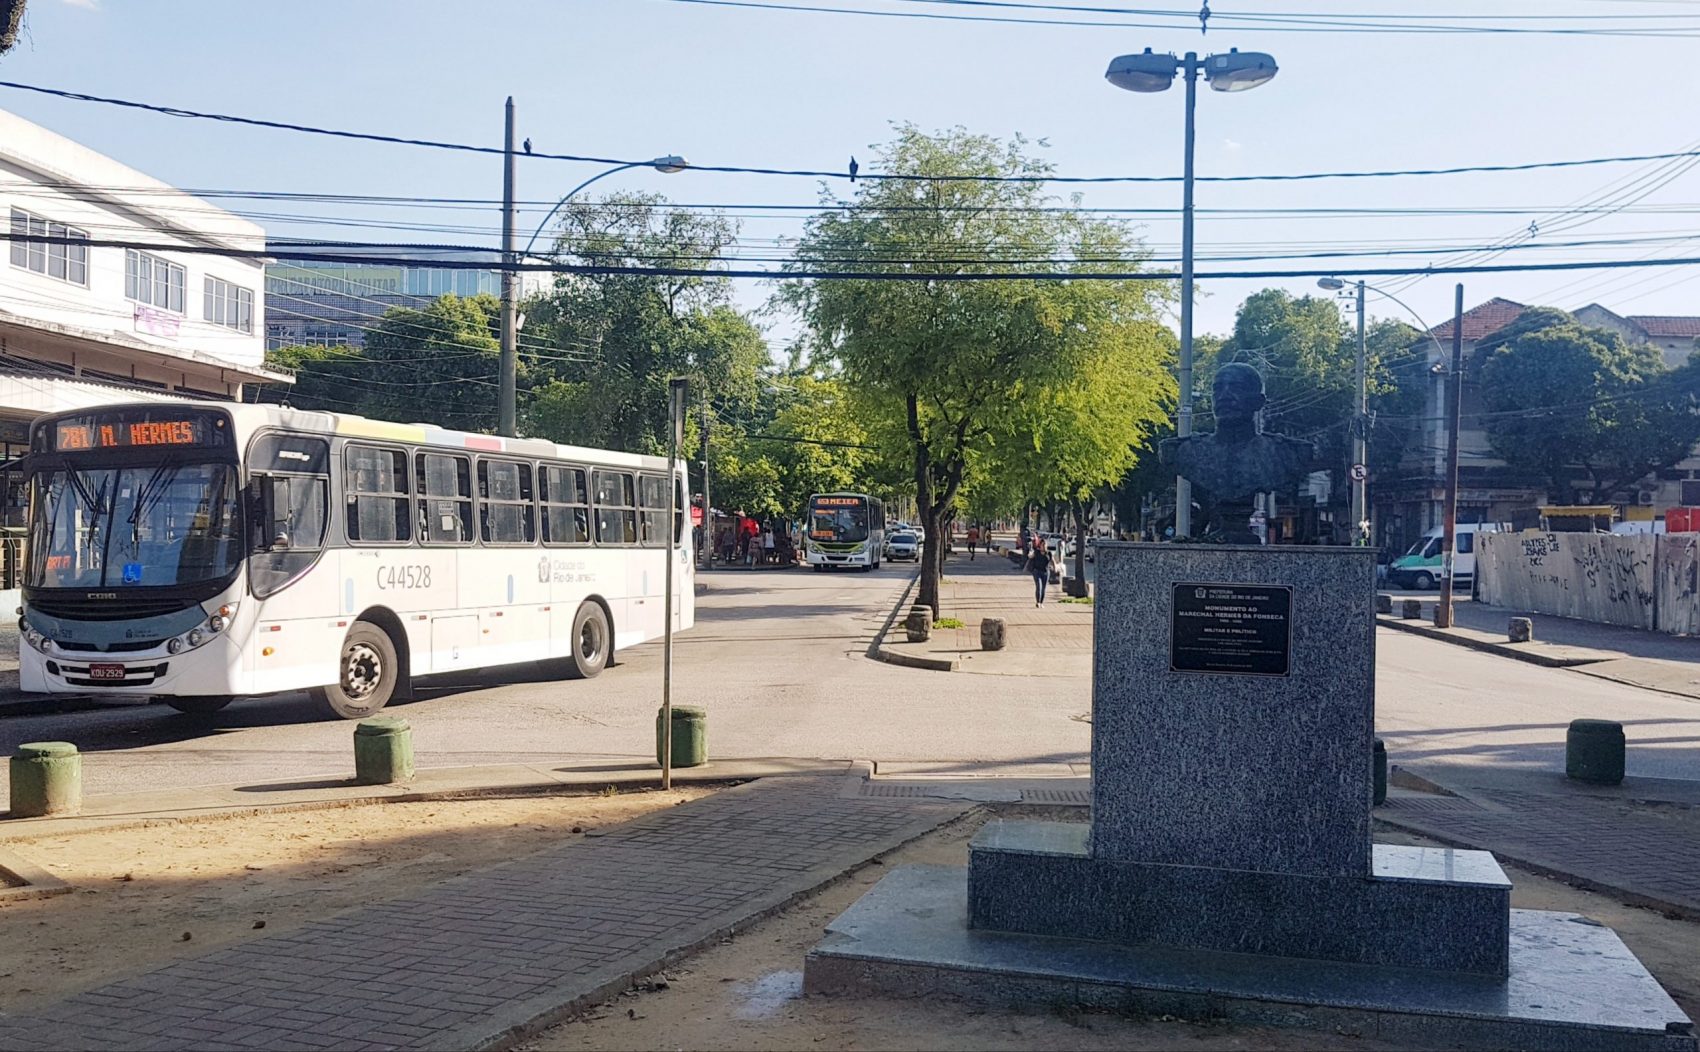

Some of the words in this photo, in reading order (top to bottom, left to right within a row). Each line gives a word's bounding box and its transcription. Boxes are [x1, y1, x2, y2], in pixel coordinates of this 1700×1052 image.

[60, 426, 89, 448] 781
[130, 421, 193, 445] HERMES
[376, 564, 431, 590] C44528
[90, 668, 124, 678] KOU-2929
